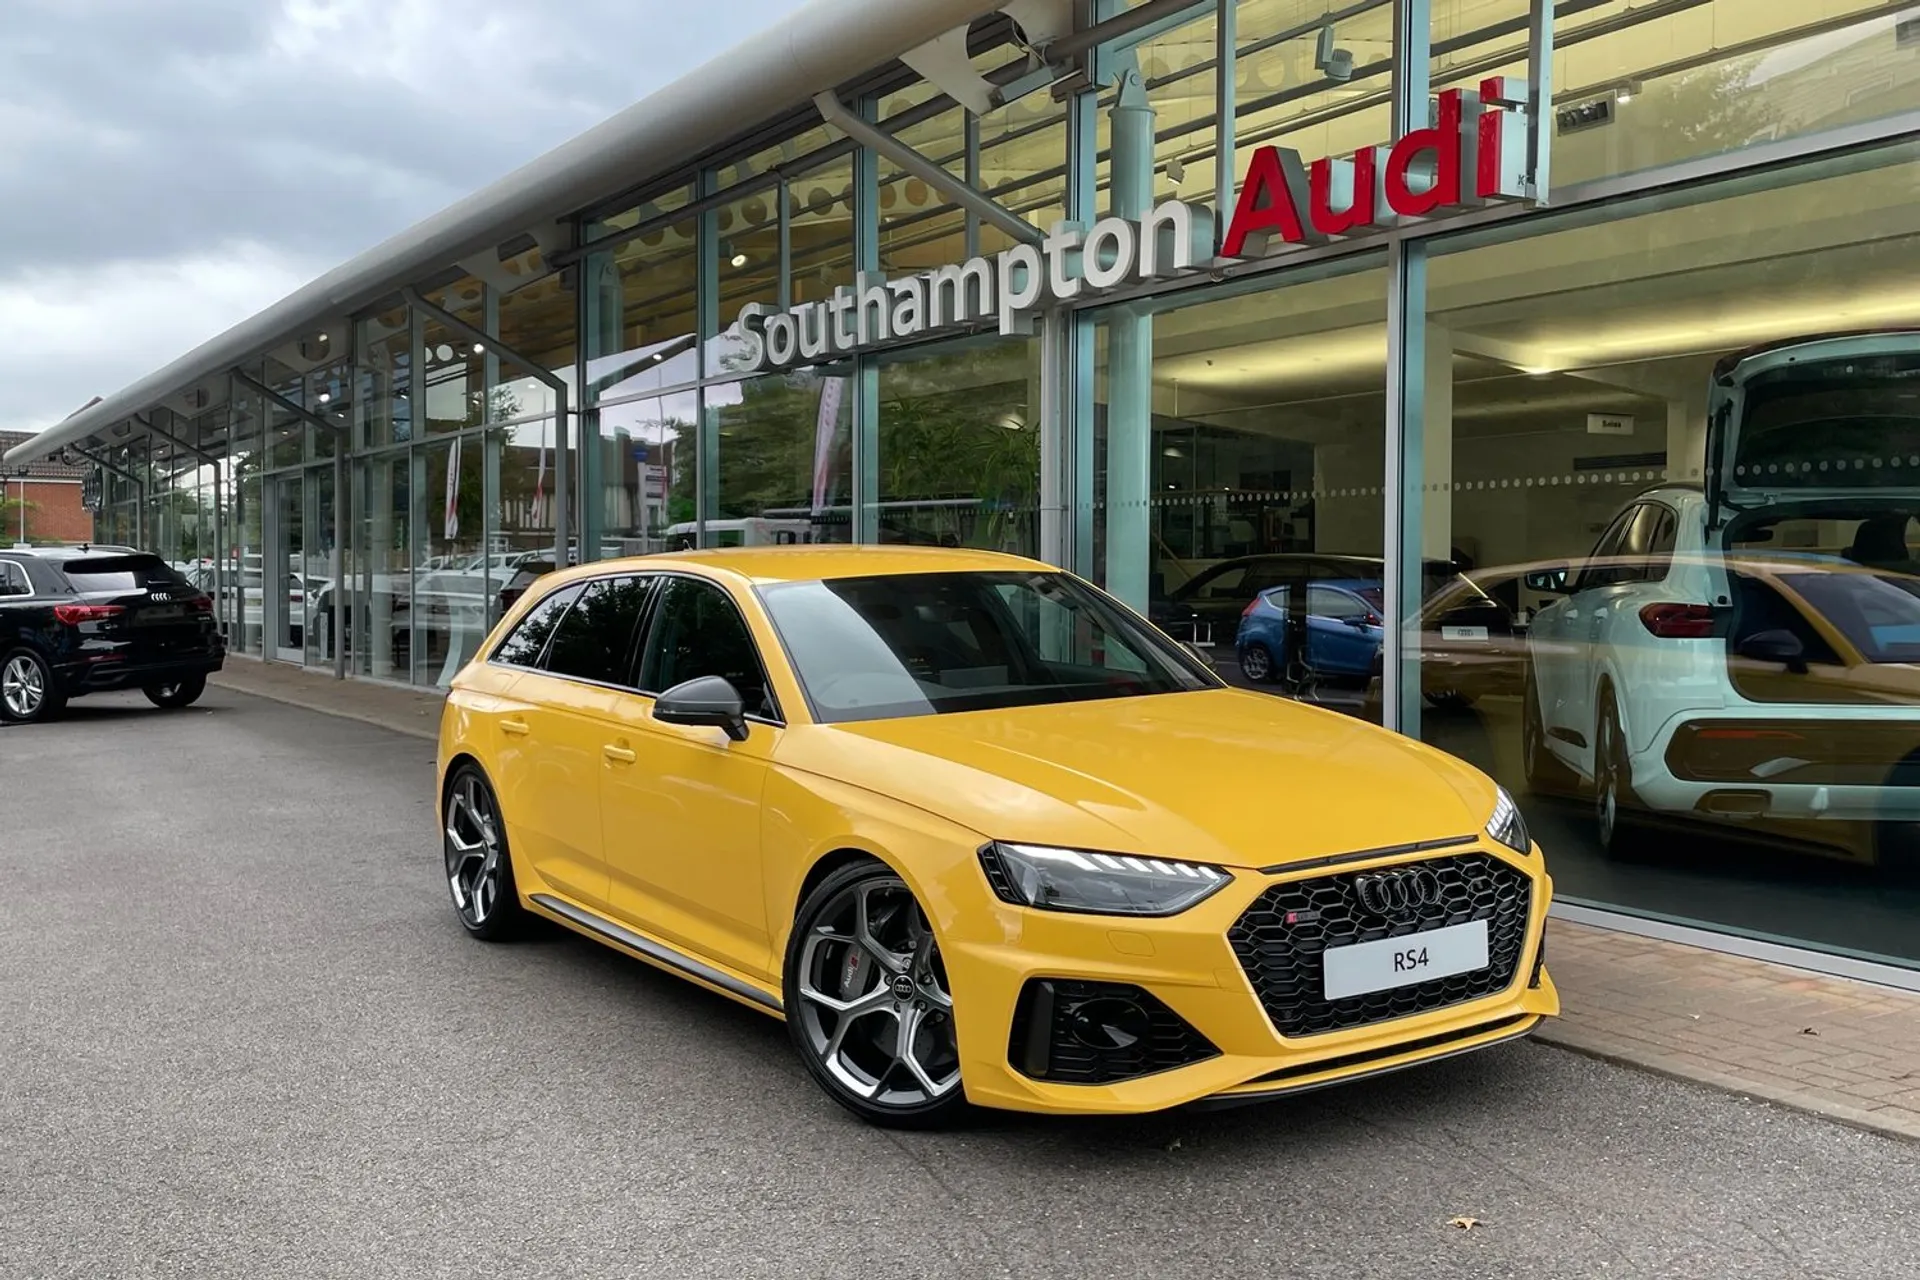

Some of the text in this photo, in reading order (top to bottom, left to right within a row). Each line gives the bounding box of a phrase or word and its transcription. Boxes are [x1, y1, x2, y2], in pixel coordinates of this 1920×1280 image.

[735, 75, 1505, 373] Southampton Audi
[1394, 946, 1429, 972] RS4
